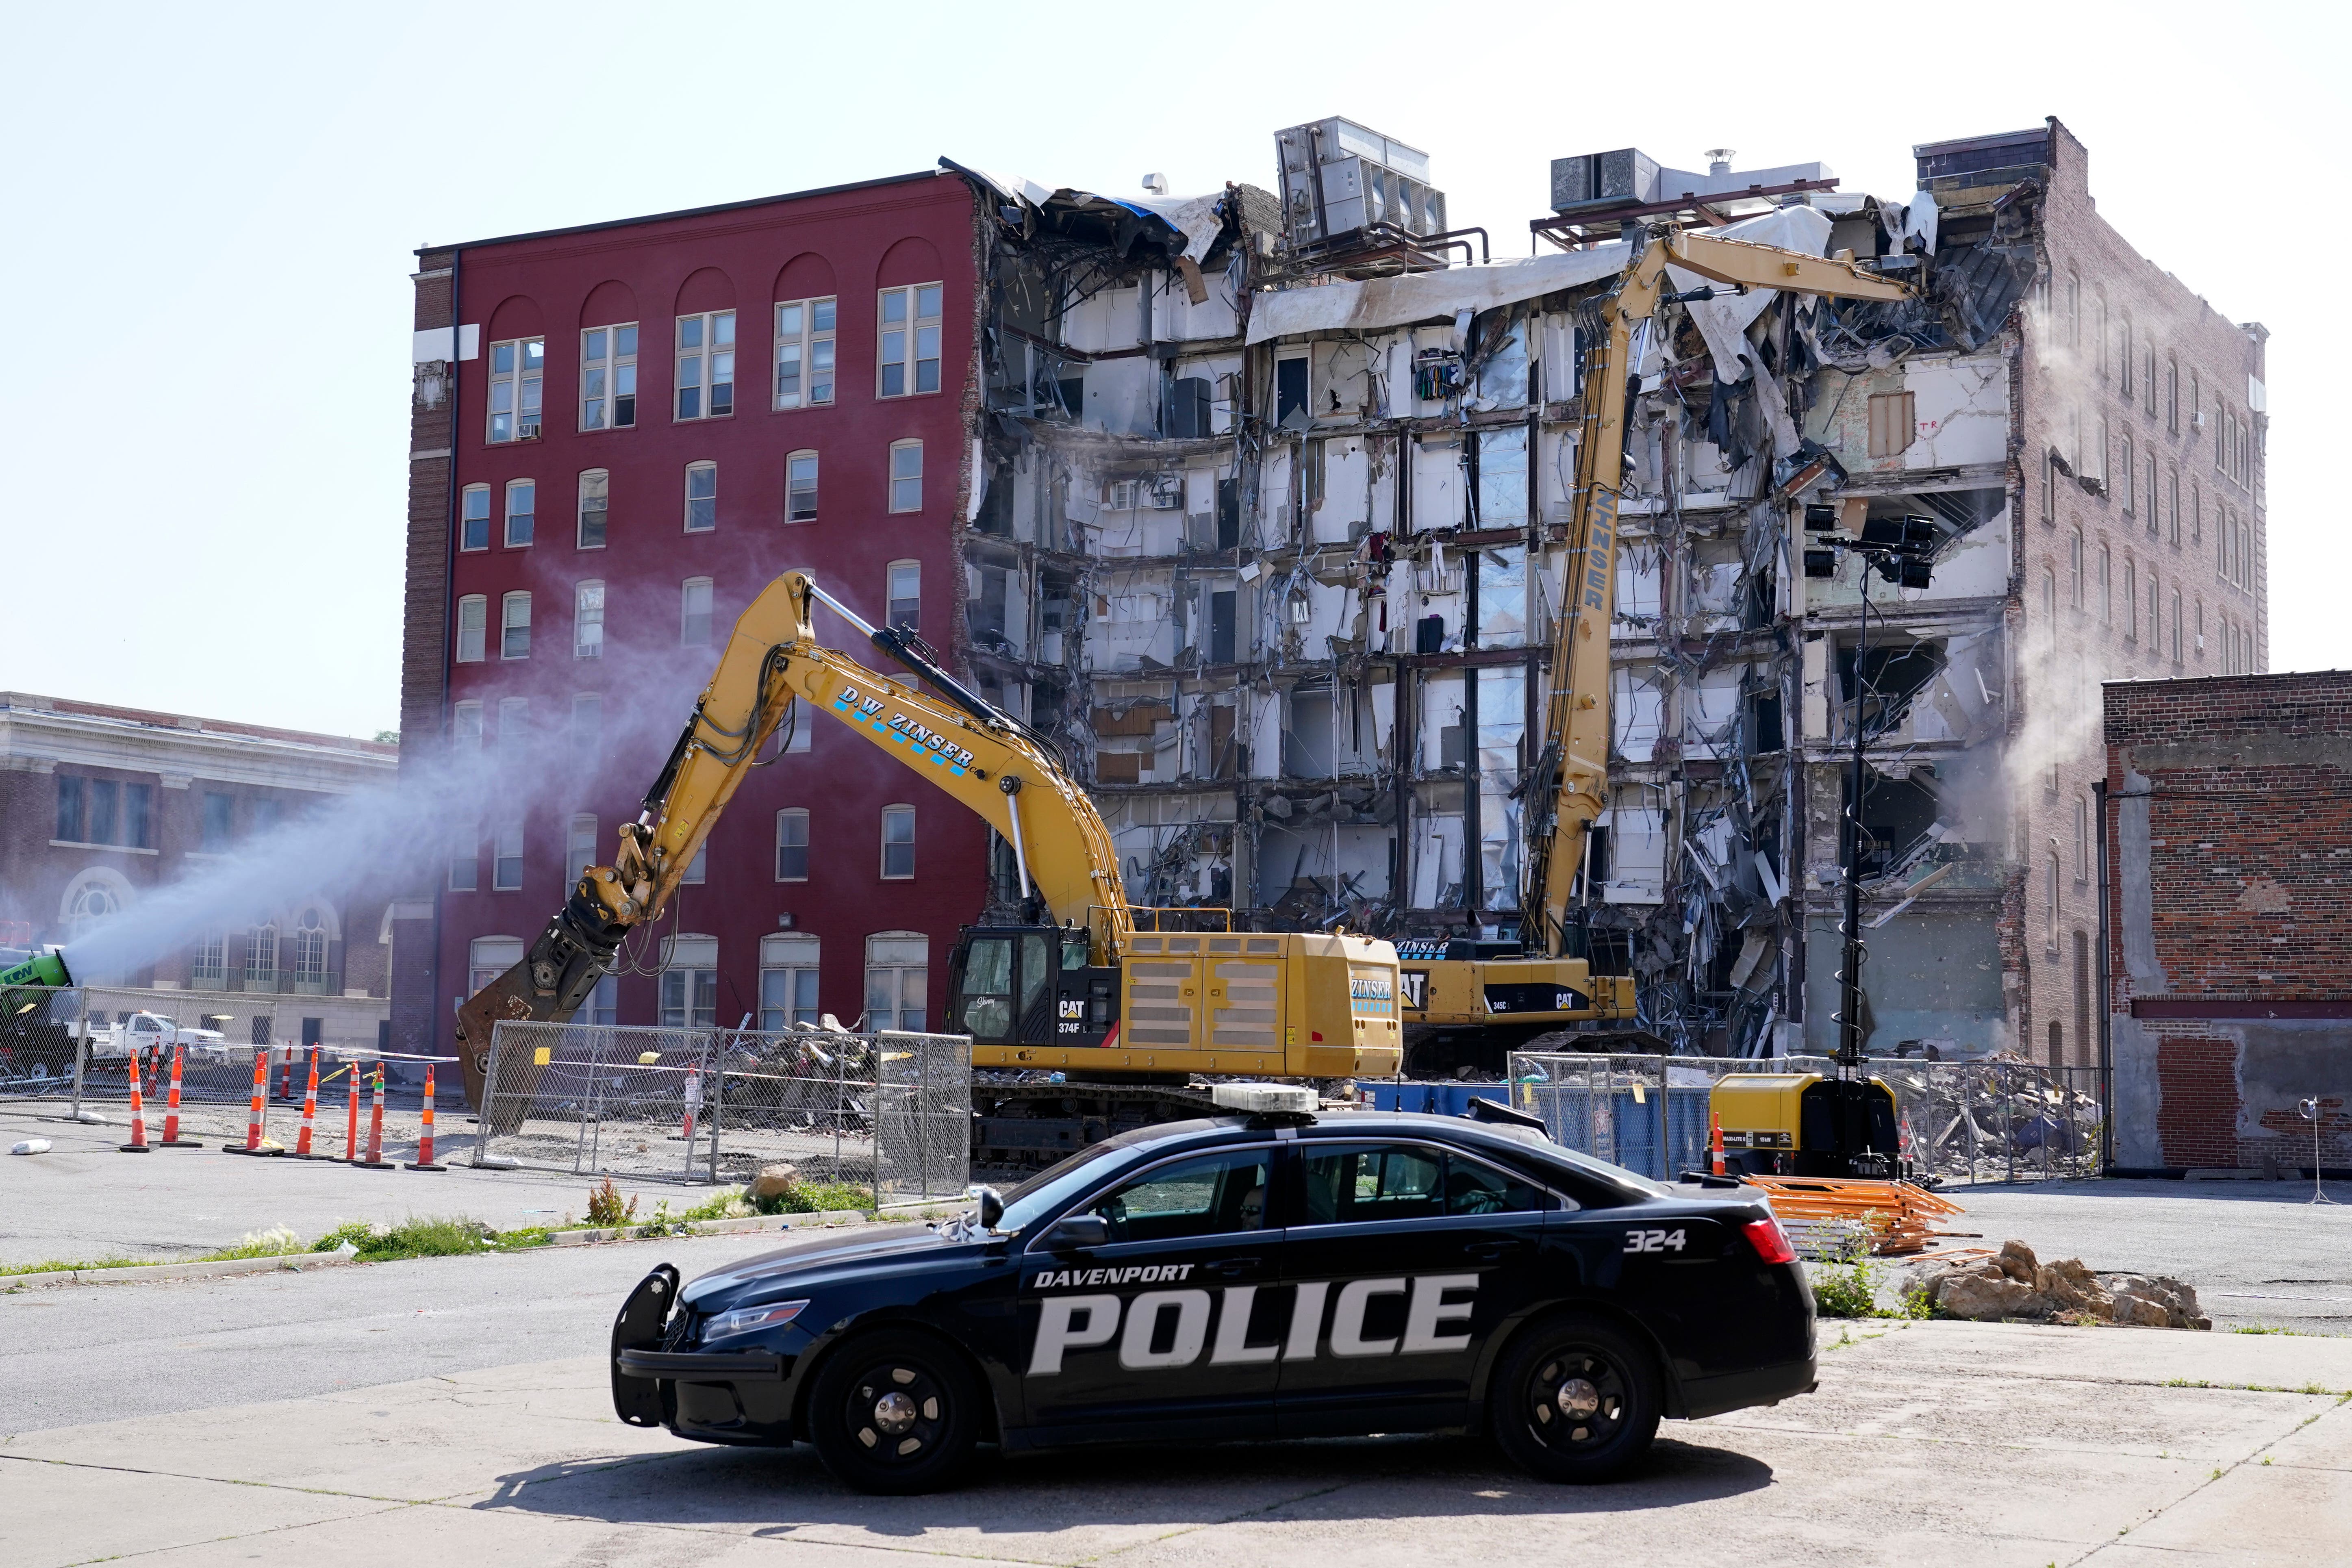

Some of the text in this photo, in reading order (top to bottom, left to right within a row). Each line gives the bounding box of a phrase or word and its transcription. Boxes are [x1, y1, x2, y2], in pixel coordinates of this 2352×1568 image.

[1585, 490, 1615, 611] ZINSER
[838, 685, 885, 720] D.W.
[887, 712, 974, 768] ZINSER
[1395, 941, 1449, 954] ZINSER
[1351, 979, 1391, 1001] ZINSER
[1400, 974, 1424, 1008] AT
[1556, 993, 1573, 1009] CAT
[1059, 1000, 1084, 1018] CAT
[1493, 1001, 1506, 1010] 345C
[1058, 1023, 1079, 1033] 374F
[1623, 1229, 1686, 1253] 324
[1034, 1264, 1194, 1288] DAVENPORT
[1025, 1273, 1479, 1379] POLICE
